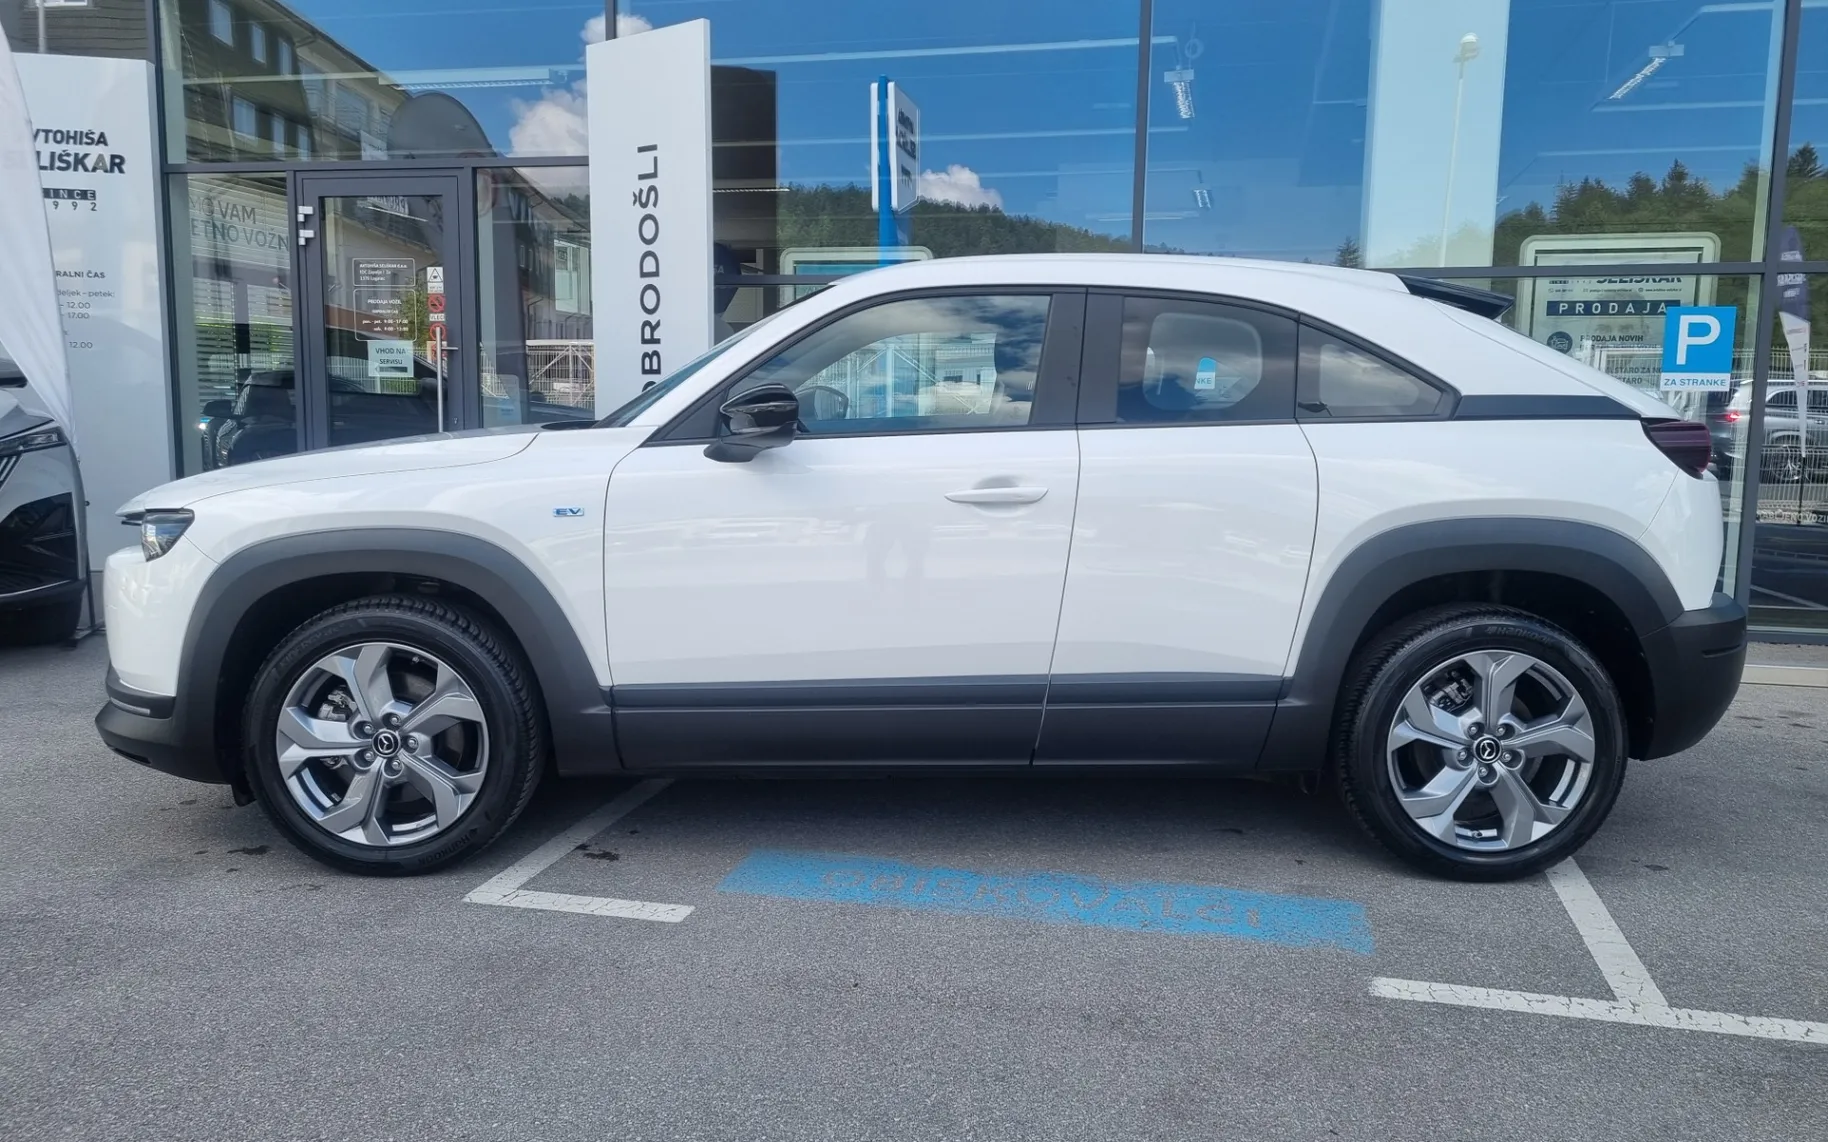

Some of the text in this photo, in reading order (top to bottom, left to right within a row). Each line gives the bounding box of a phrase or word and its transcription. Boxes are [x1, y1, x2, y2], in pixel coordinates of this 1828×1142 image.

[52, 200, 98, 211] 992
[218, 200, 256, 224] VAM
[632, 143, 662, 393] BRODOŠLI
[86, 270, 106, 279] ČAS
[66, 301, 91, 309] 12.00
[1559, 302, 1668, 315] PRODAJA
[1580, 334, 1644, 342] PRODAJA NOVIH
[1676, 314, 1721, 365] P
[69, 341, 93, 349] 12.00
[1679, 378, 1727, 387] STRANKE
[555, 508, 582, 516] EV
